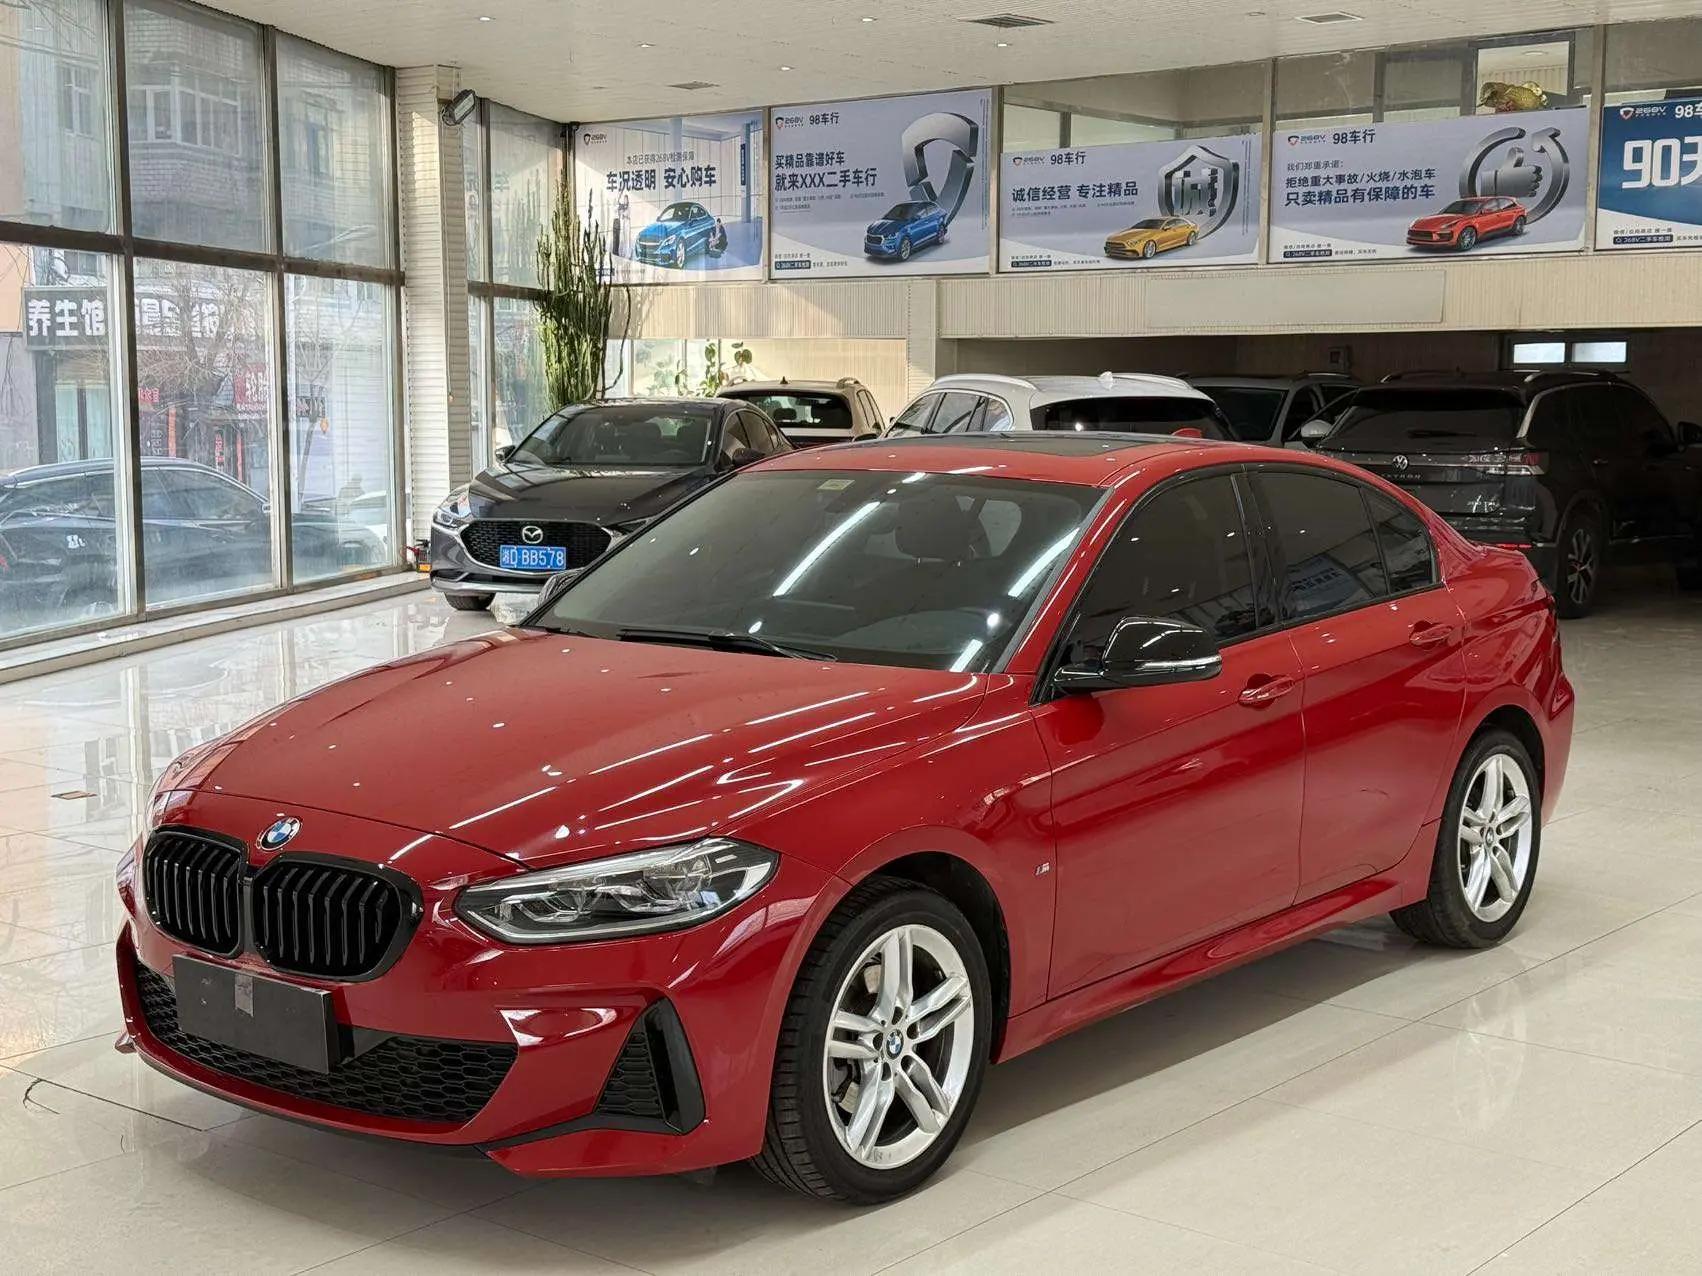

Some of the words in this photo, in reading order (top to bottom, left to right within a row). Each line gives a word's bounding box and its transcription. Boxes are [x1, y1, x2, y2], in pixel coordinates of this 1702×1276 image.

[809, 112, 839, 126] 98车行
[1333, 129, 1376, 144] 98车行
[775, 150, 845, 170] 买精品靠谱好车
[1050, 151, 1086, 166] 98车行
[606, 169, 656, 192] 车况透明
[664, 165, 716, 189] 安心购车
[775, 168, 877, 192] 就来XXX二手车行
[1286, 168, 1436, 188] 拒绝重大事故/火烧/水泡车
[1012, 185, 1071, 202] 诚信经营
[1077, 181, 1138, 198] 专注精品
[1285, 184, 1435, 207] 只卖精品有保障的车
[28, 299, 105, 337] 养生馆
